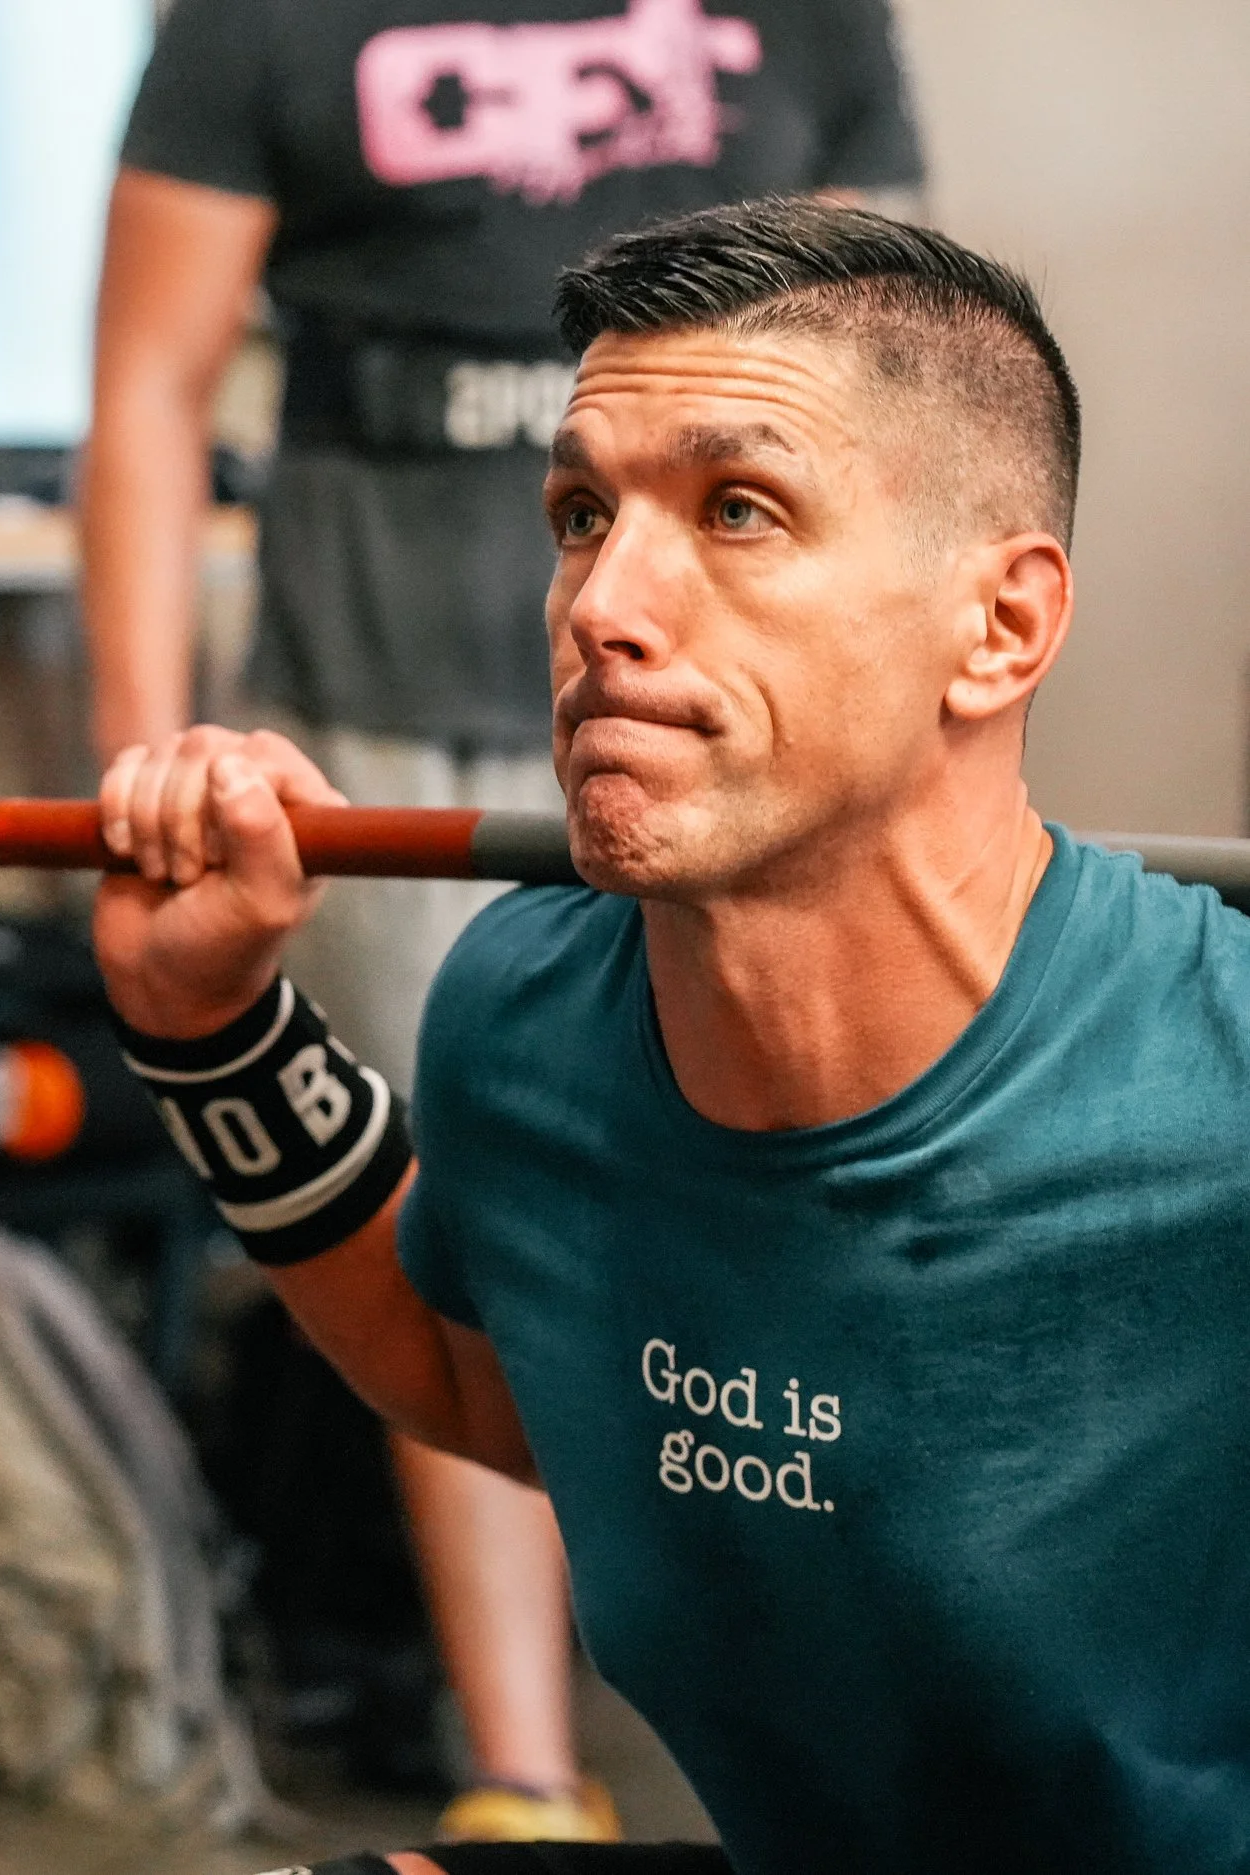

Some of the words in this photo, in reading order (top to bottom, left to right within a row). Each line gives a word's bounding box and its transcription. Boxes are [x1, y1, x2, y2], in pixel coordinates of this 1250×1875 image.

[642, 1338, 763, 1430] God
[783, 1378, 842, 1442] is
[659, 1429, 835, 1512] good.
